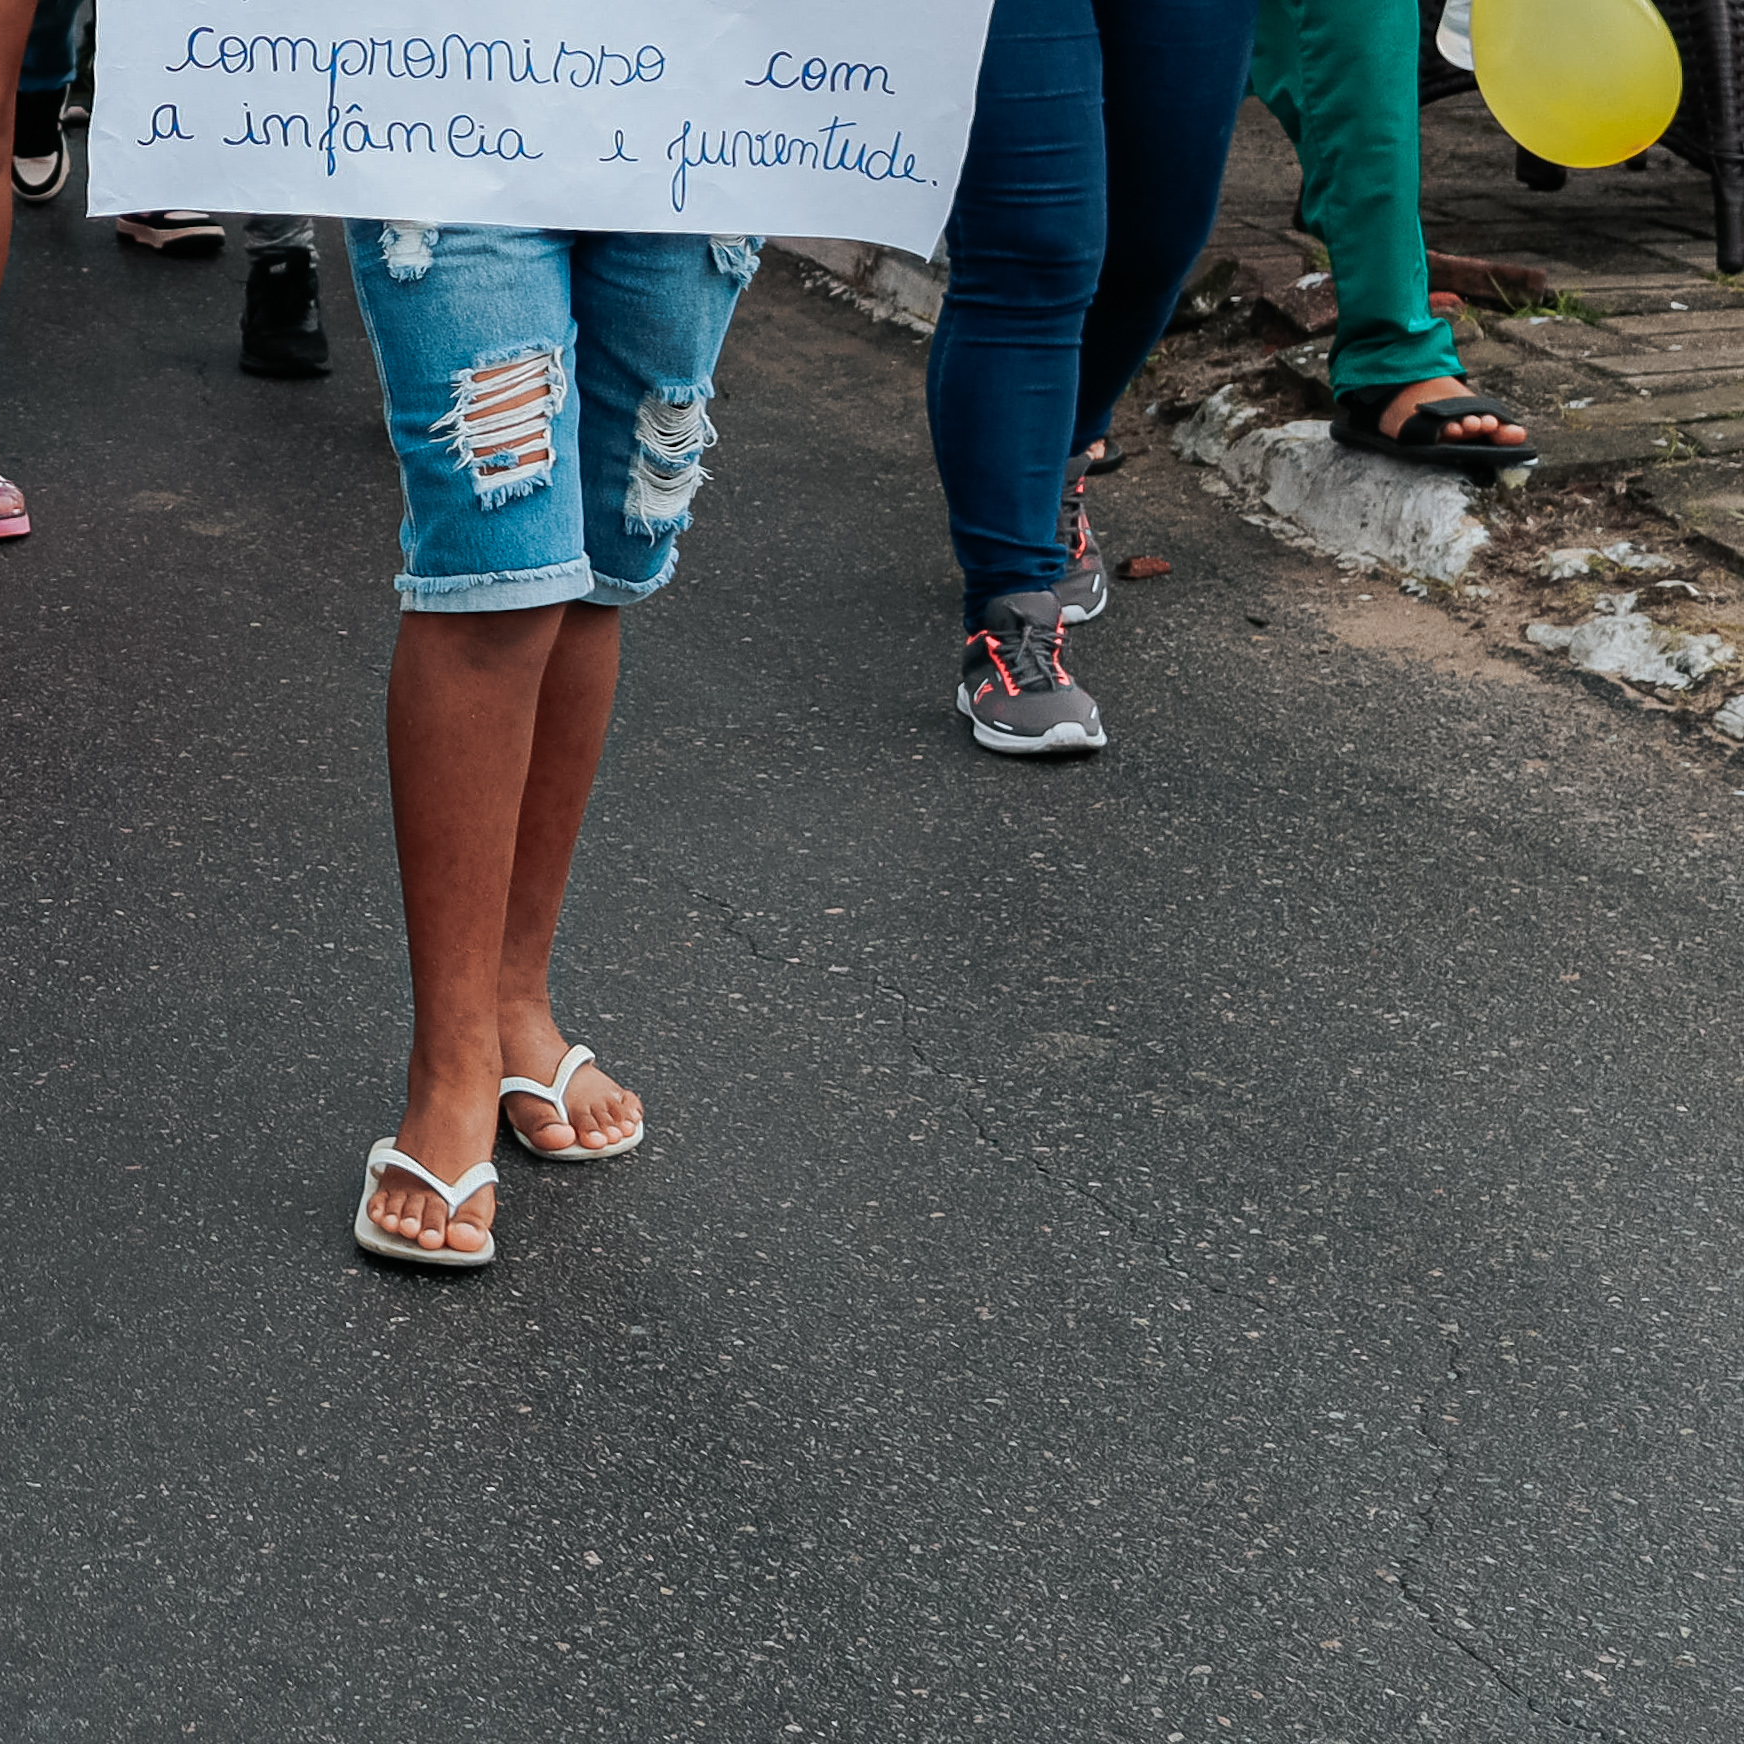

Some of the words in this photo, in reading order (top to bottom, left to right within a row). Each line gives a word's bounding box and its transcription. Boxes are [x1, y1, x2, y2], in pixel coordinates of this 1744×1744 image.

[164, 25, 667, 138] compromisso
[744, 50, 897, 96] com
[136, 103, 196, 148] a
[222, 101, 546, 178] infância
[598, 129, 640, 163] e
[666, 115, 941, 213] juventude.
